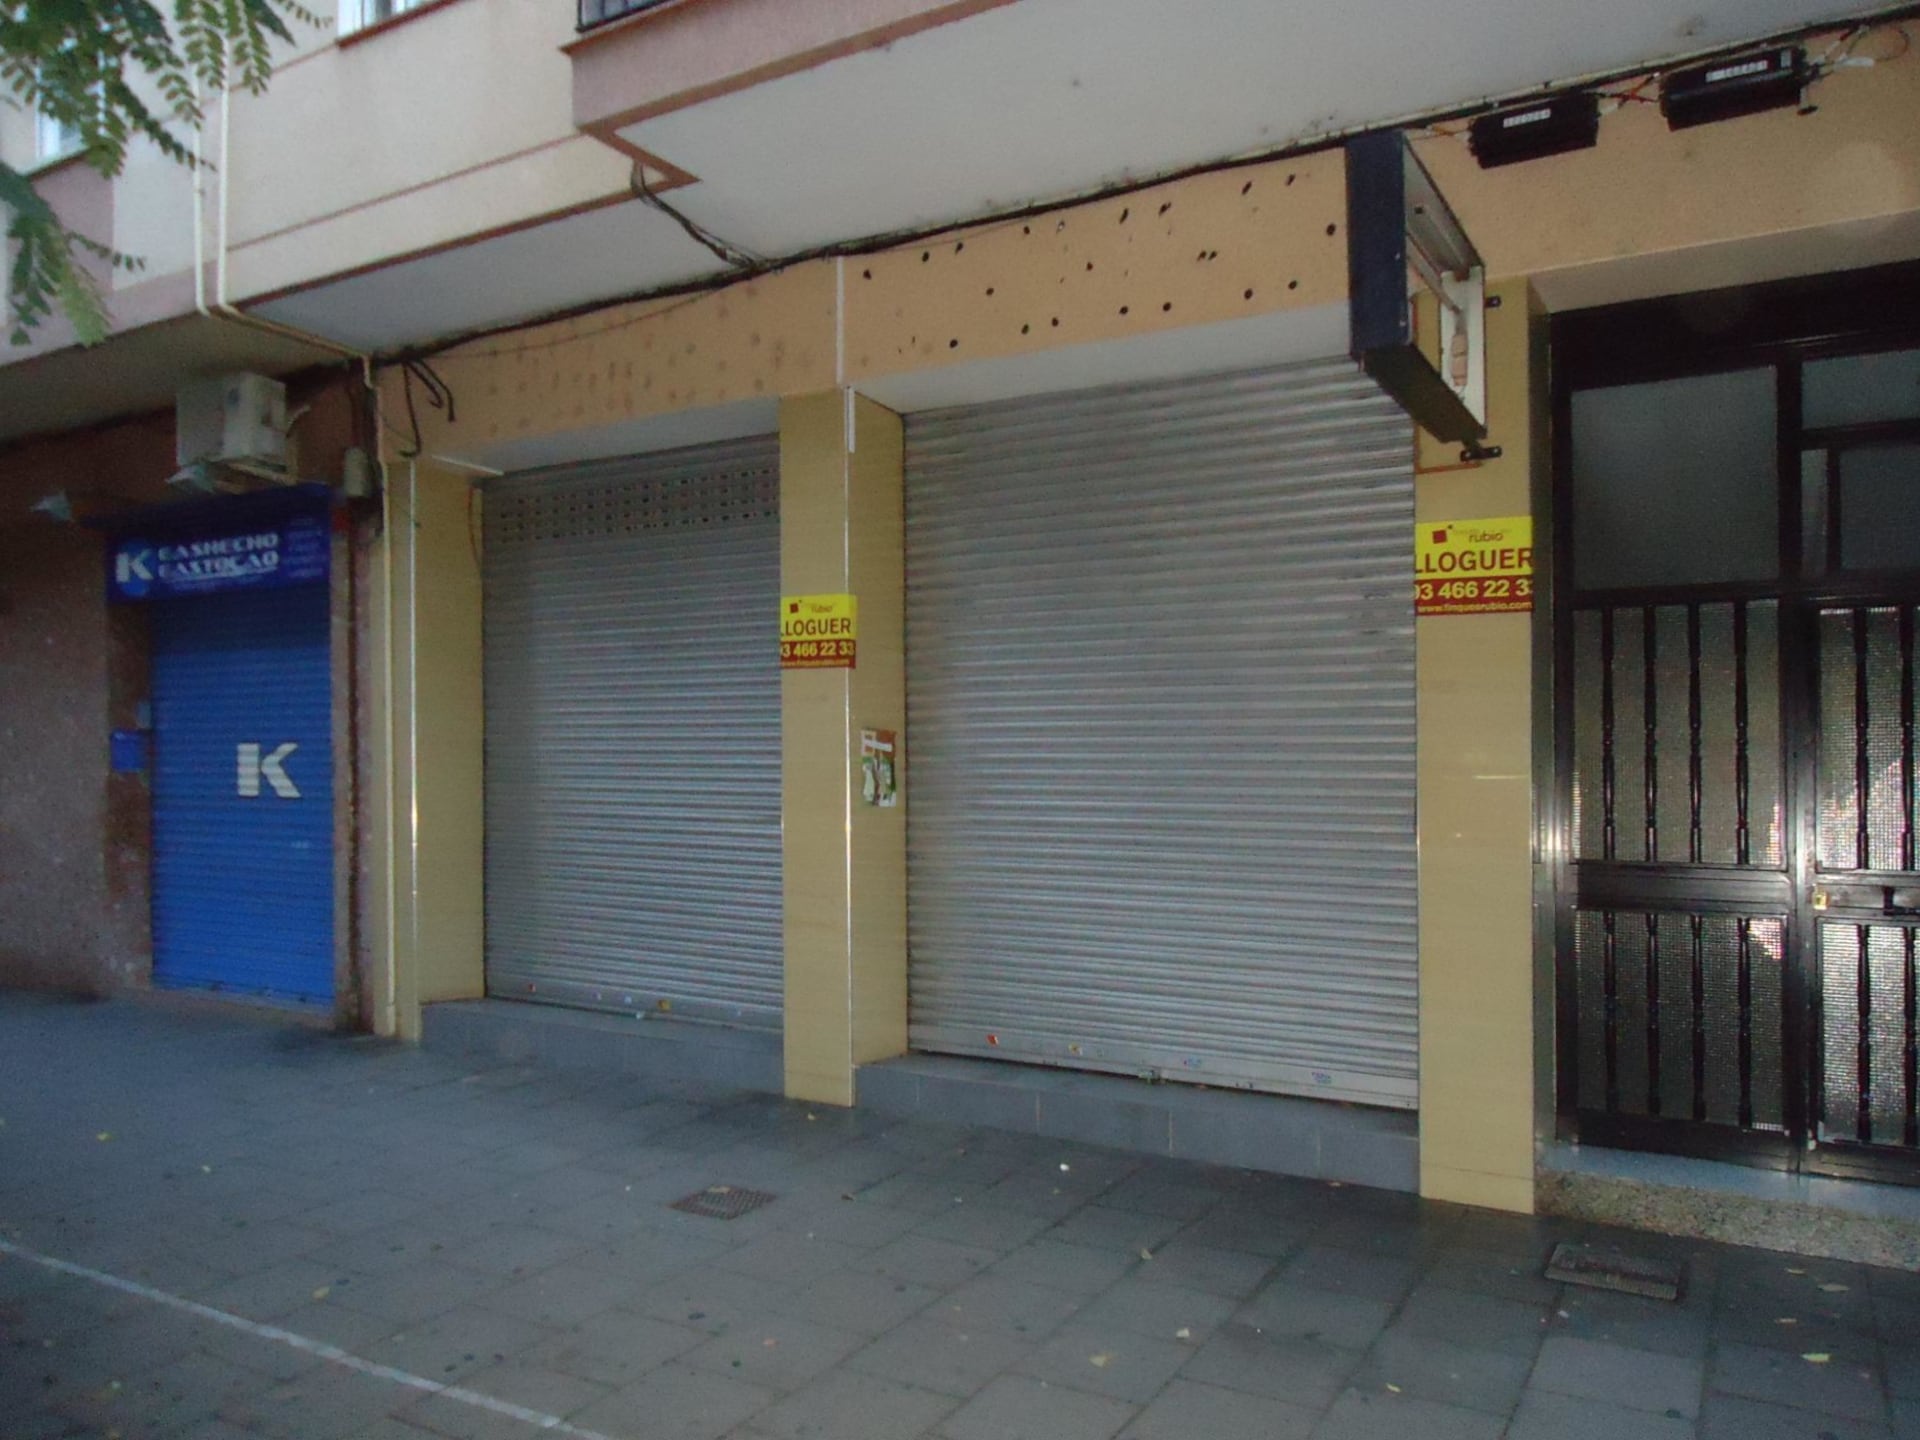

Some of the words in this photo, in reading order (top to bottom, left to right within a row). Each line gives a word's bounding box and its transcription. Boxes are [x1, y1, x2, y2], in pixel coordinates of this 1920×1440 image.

[1469, 529, 1504, 543] rubio
[116, 549, 154, 583] K
[1438, 581, 1479, 599] 466
[1483, 579, 1511, 597] 22
[1515, 578, 1533, 596] 3
[781, 617, 852, 636] LOGUER
[780, 643, 791, 657] 3
[793, 642, 818, 657] 466
[820, 641, 836, 656] 22
[839, 640, 855, 655] 33
[236, 741, 302, 799] K
